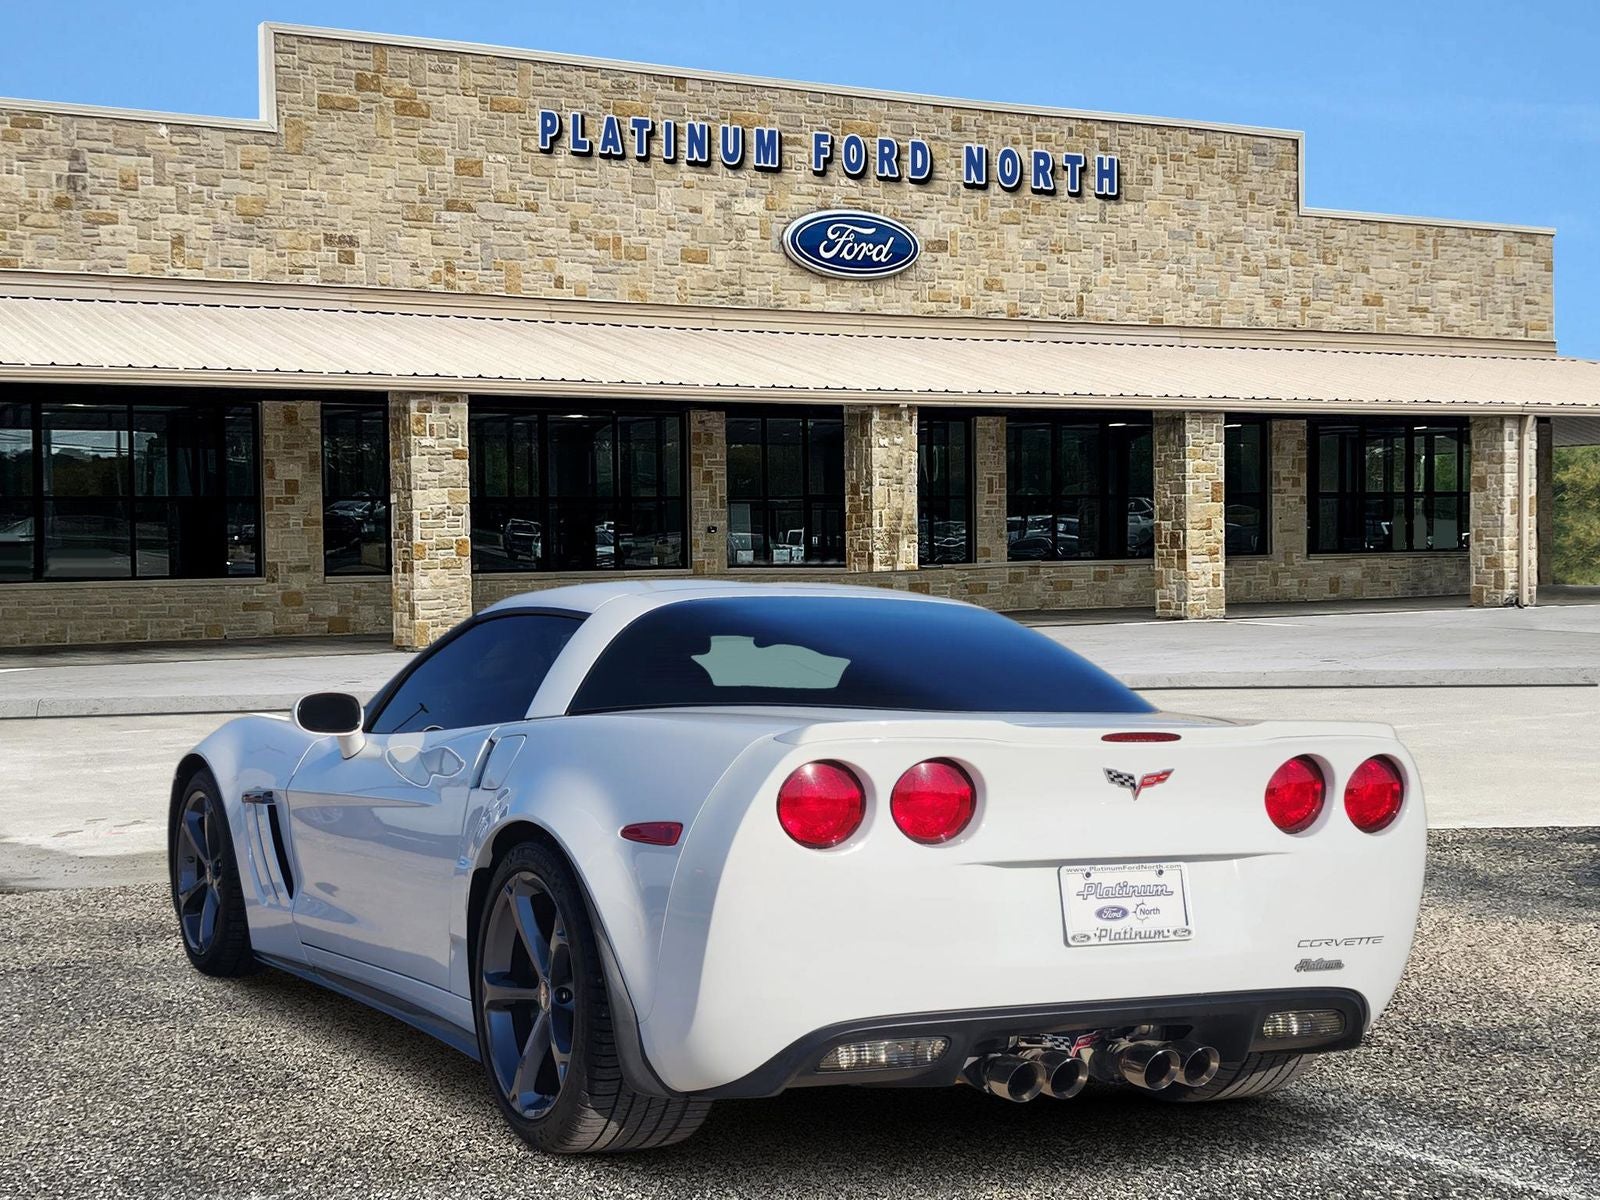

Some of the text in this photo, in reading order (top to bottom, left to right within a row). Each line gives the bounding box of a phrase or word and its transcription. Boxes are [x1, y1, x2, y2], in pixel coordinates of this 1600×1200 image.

[538, 109, 1120, 199] PLATINUM FORD NORTH
[818, 223, 895, 263] Ford
[1066, 864, 1181, 872] www.PlatinumFordNorth.com
[1076, 881, 1174, 900] Platinum
[1101, 906, 1123, 919] Ford
[1139, 906, 1160, 916] North
[1093, 927, 1171, 942] Platinum
[1297, 935, 1384, 948] CORVETTE
